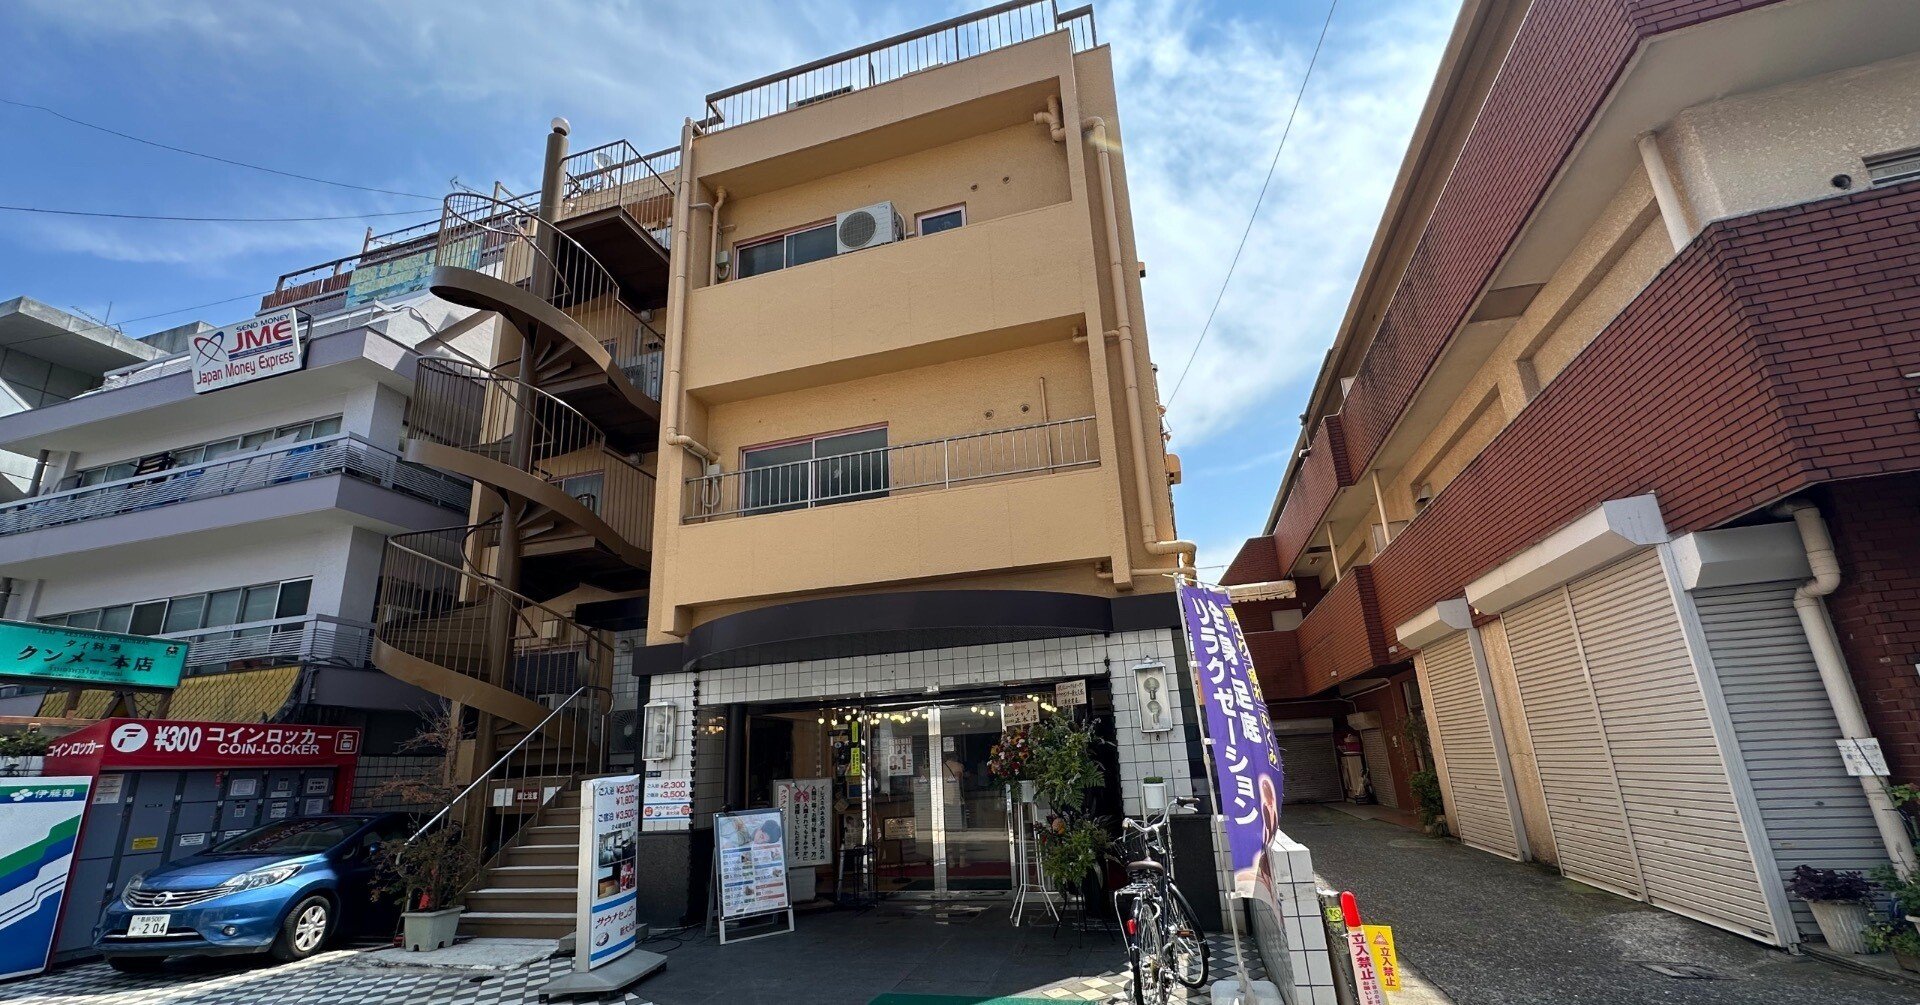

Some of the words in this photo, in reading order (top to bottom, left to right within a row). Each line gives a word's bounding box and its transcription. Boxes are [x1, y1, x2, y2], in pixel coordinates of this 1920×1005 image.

[236, 322, 258, 332] SEND
[260, 313, 290, 326] MONEY
[227, 319, 293, 354] JME
[196, 367, 223, 386] Japan
[225, 361, 256, 377] Money
[258, 351, 295, 370] Express
[64, 640, 121, 652] タイ料理
[16, 645, 155, 673] クンメー本店
[1191, 597, 1259, 825] リラクゼーション
[153, 725, 202, 752] ¥300
[206, 726, 333, 745] コインロッカー
[1260, 711, 1278, 766] むくみ
[46, 740, 104, 757] コインロッカー
[217, 743, 320, 755] COIN-LOCKER
[34, 788, 75, 799] 伊藤園
[598, 786, 615, 797] ご入浴
[616, 784, 635, 795] ¥2,300
[615, 795, 635, 806] ¥1,800
[597, 812, 614, 823] ご宿泊
[615, 808, 635, 820] ¥3,500
[1351, 933, 1375, 980] 立入禁止
[1380, 946, 1397, 987] 立入禁止
